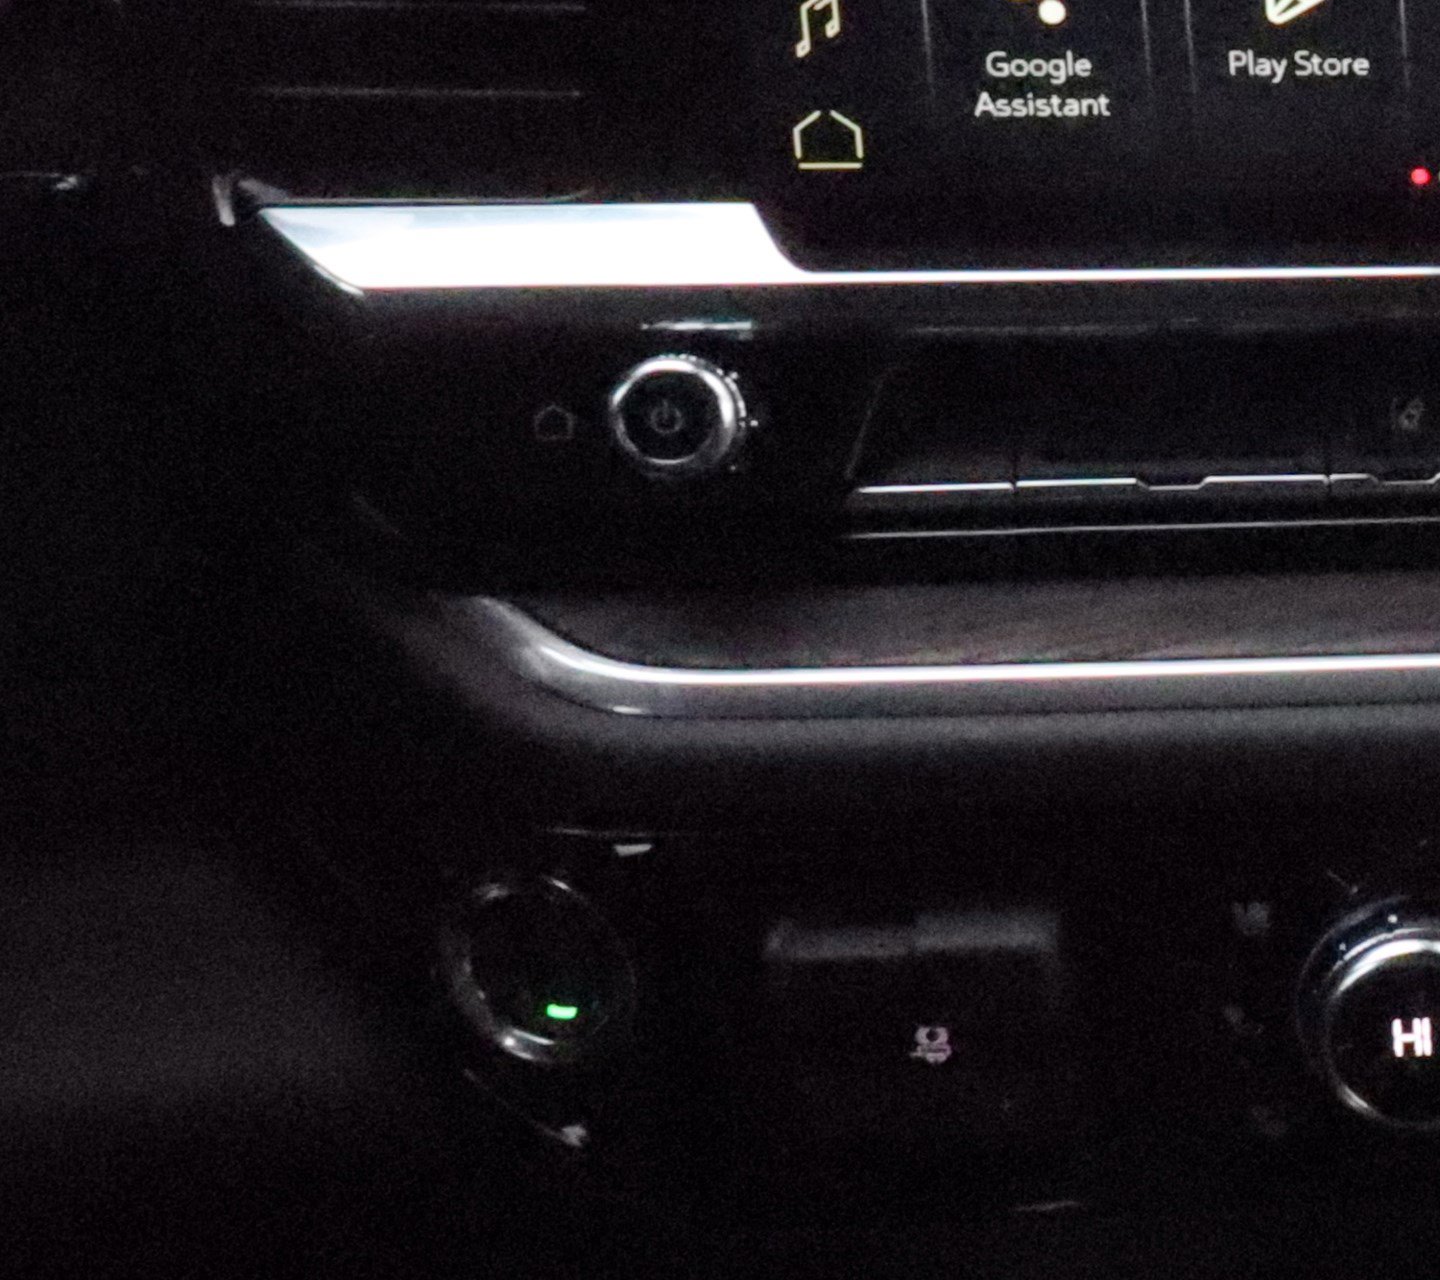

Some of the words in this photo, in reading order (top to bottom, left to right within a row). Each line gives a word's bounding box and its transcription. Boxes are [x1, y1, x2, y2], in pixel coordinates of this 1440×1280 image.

[985, 50, 1092, 84] Google
[1227, 50, 1287, 85] Play
[1293, 51, 1370, 77] Store
[974, 91, 1110, 119] Assistant
[1390, 1016, 1435, 1058] HI
